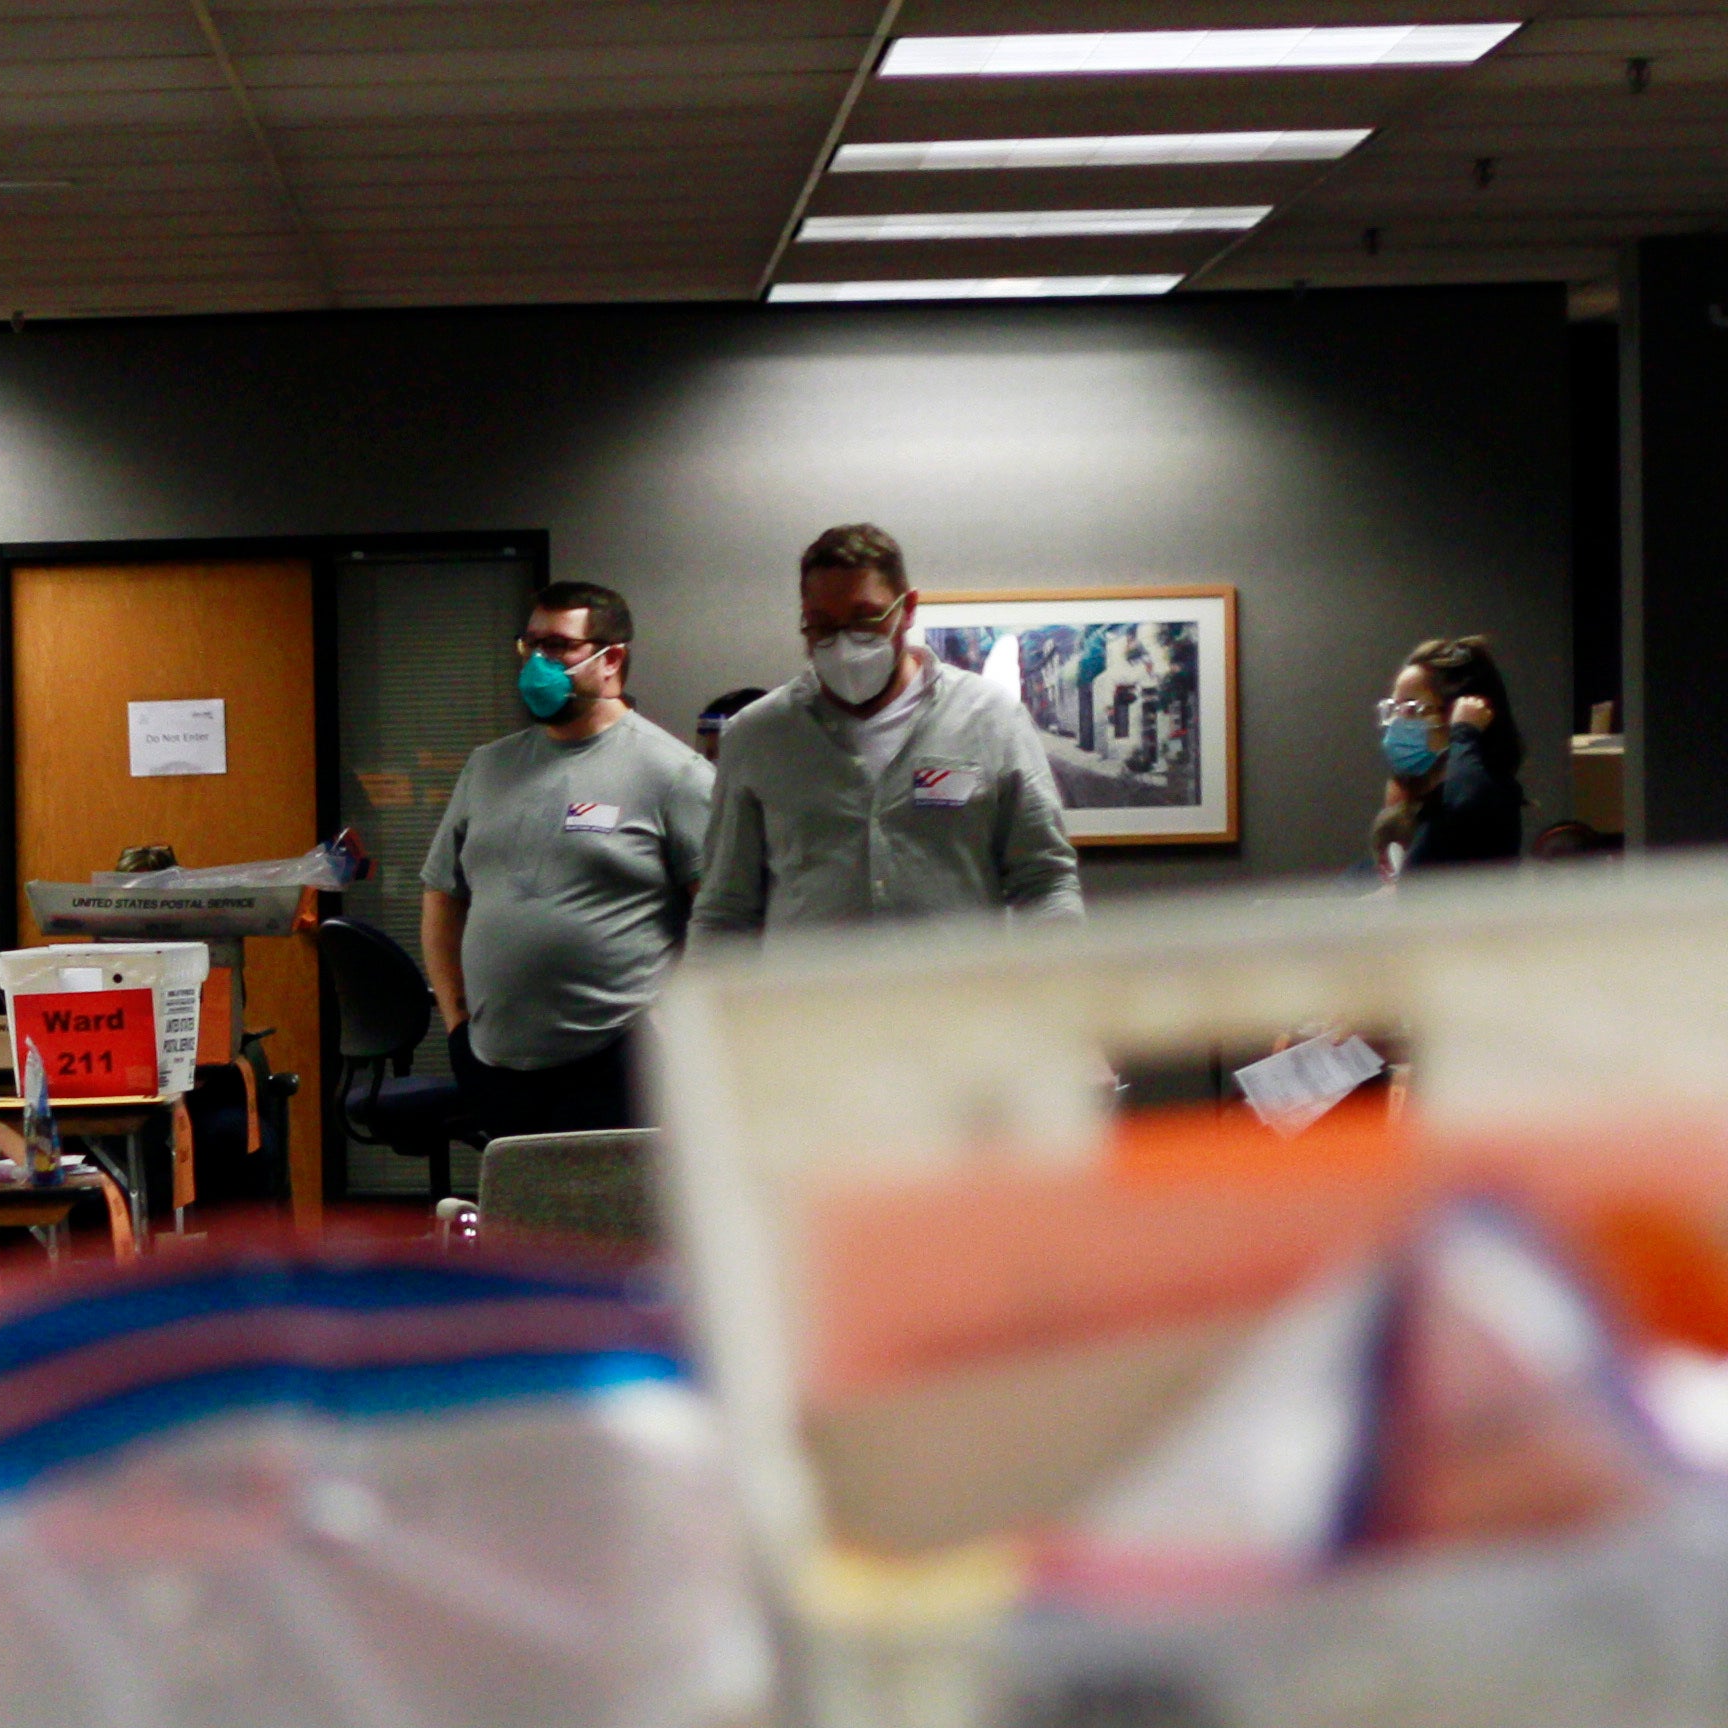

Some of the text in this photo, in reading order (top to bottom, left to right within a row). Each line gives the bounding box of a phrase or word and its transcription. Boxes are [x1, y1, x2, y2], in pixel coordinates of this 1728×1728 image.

[146, 733, 209, 743] Do Not Enter
[71, 897, 257, 910] UNITED STATES POSTAL SERVICE
[42, 1008, 125, 1033] Ward
[58, 1050, 115, 1076] 211
